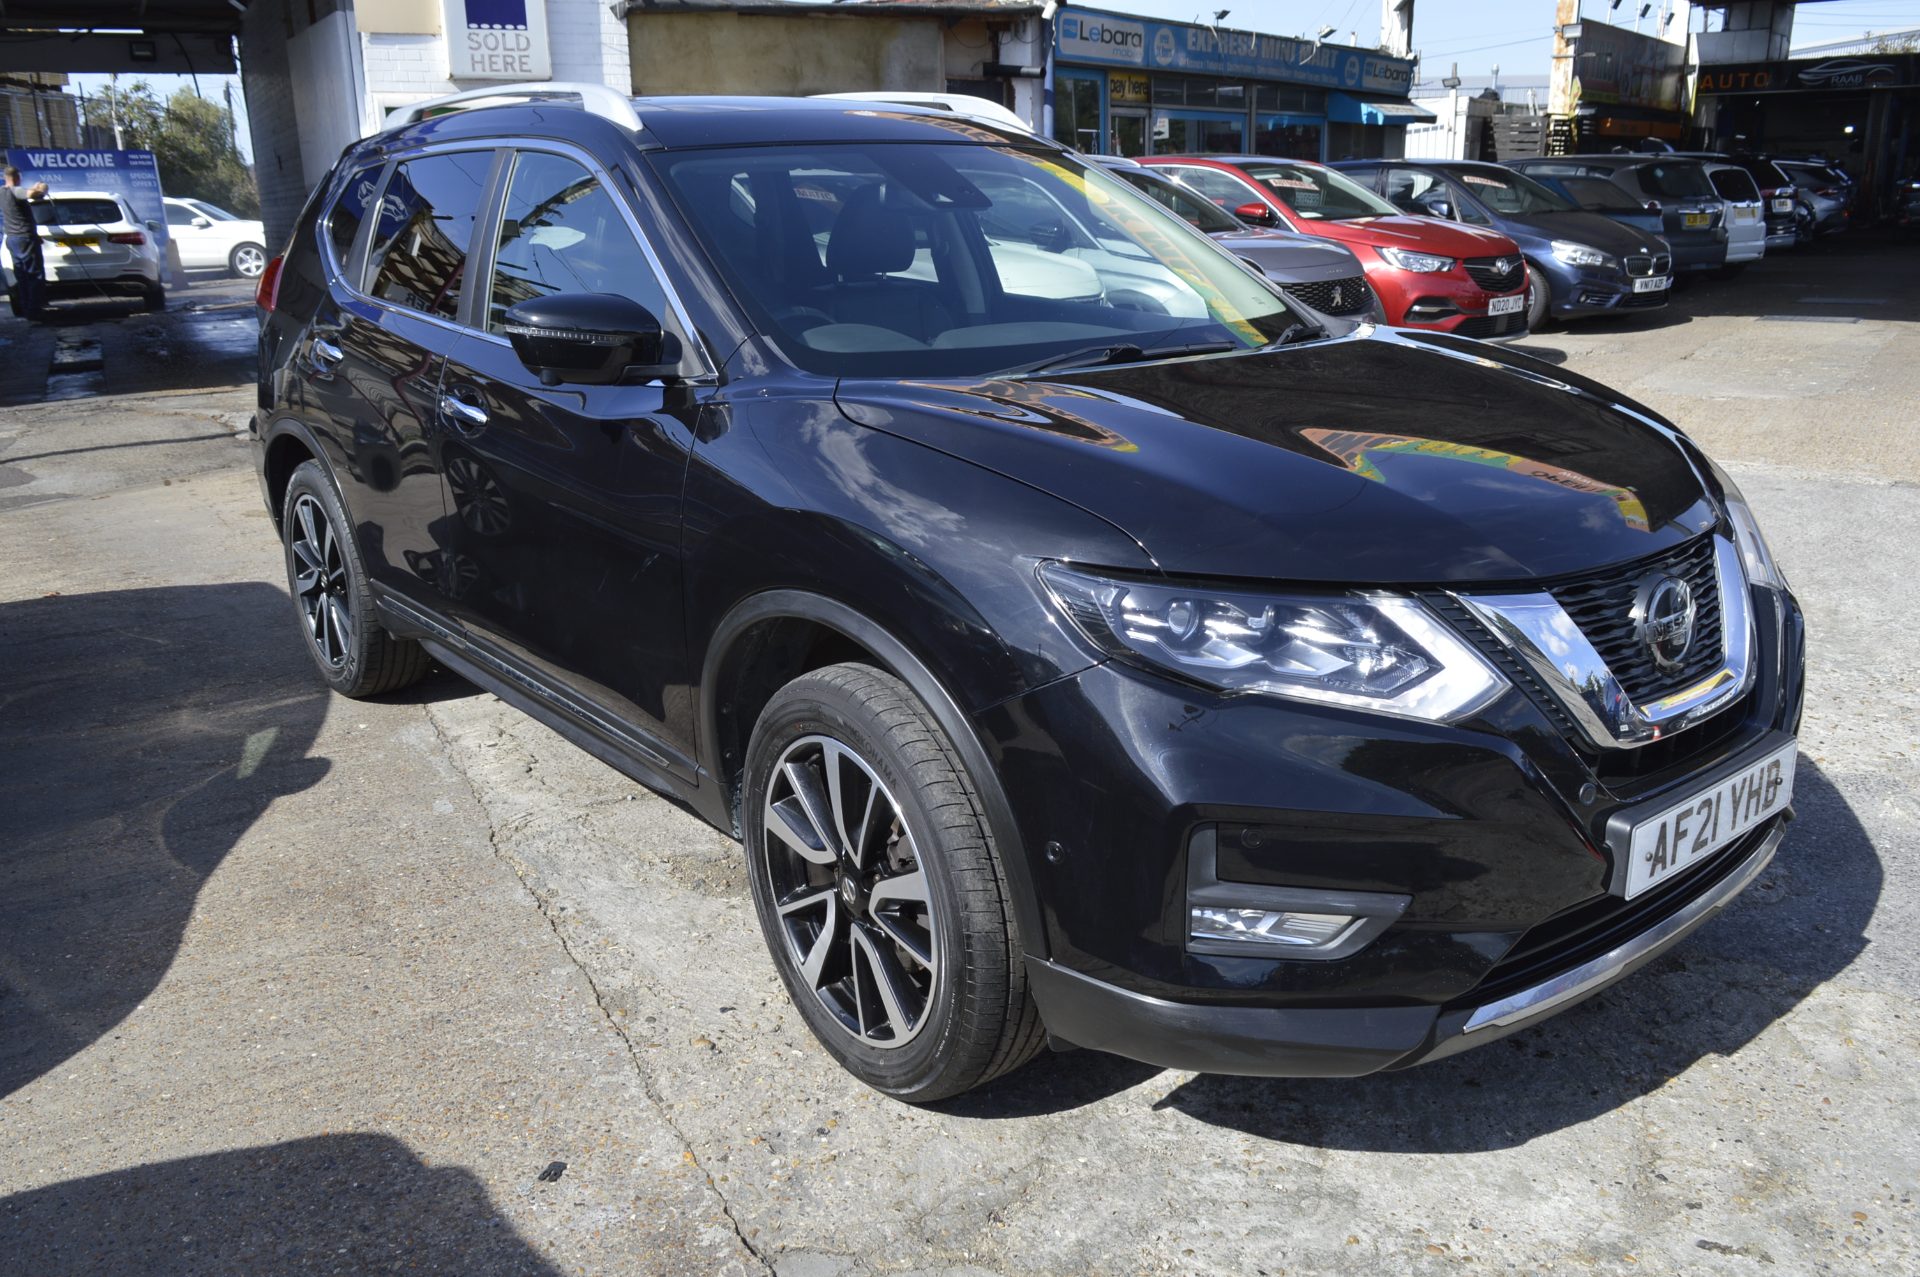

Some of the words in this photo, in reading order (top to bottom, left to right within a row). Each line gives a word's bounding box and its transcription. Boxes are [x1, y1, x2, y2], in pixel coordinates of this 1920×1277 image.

[467, 32, 531, 51] SOLD
[1080, 20, 1142, 48] Lebara
[1187, 28, 1257, 57] EXPRESS
[1261, 37, 1297, 63] MINI
[1301, 44, 1339, 69] MART
[471, 54, 532, 73] HERE
[1373, 62, 1409, 82] Lebara
[1110, 77, 1126, 98] pay
[1128, 75, 1148, 95] here
[1700, 72, 1770, 89] AUTO
[27, 153, 115, 168] WELCOME
[40, 174, 62, 183] VAN
[1491, 298, 1509, 313] ND20
[1649, 792, 1722, 878] AF21
[1731, 759, 1781, 831] YHB
